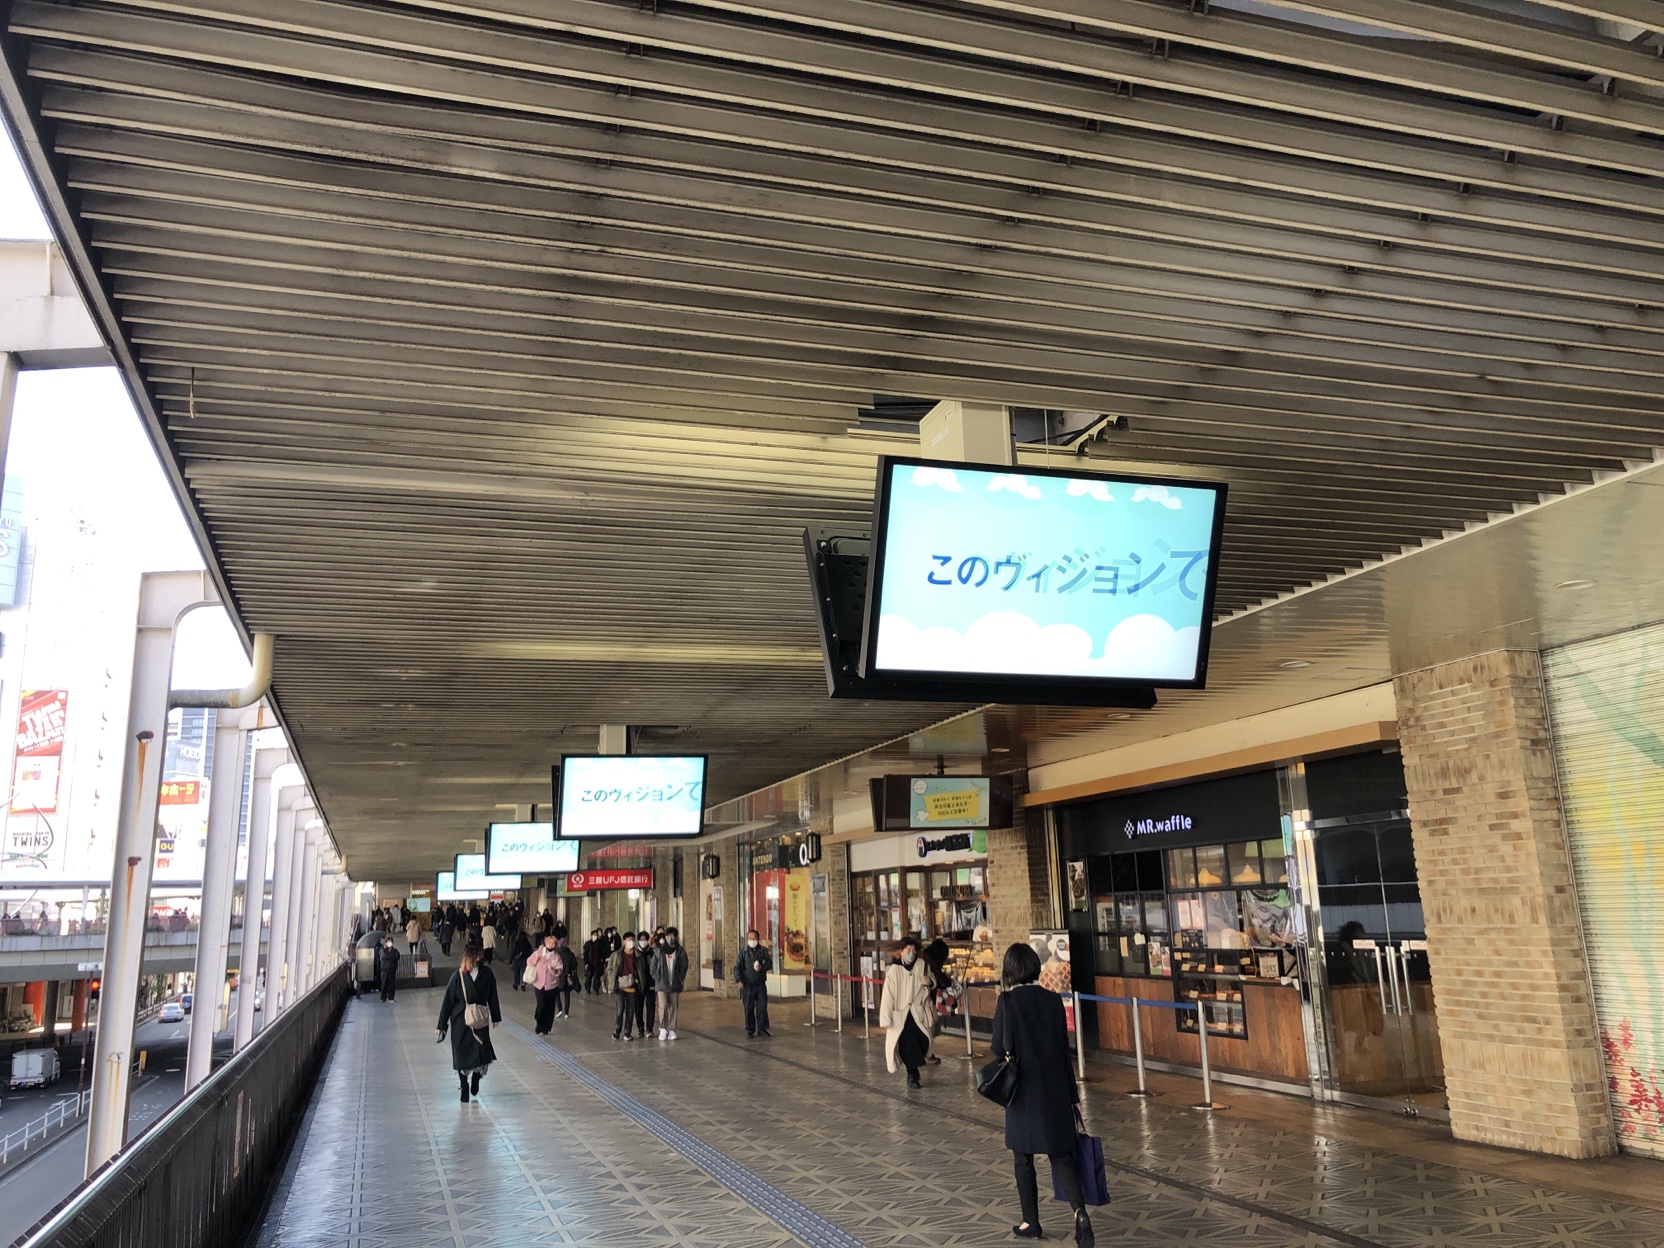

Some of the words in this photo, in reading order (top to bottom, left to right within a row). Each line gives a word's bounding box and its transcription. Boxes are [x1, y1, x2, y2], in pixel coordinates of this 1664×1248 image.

[1136, 814, 1192, 835] MR.waffle
[12, 836, 49, 847] TWINS
[160, 843, 174, 851] GU
